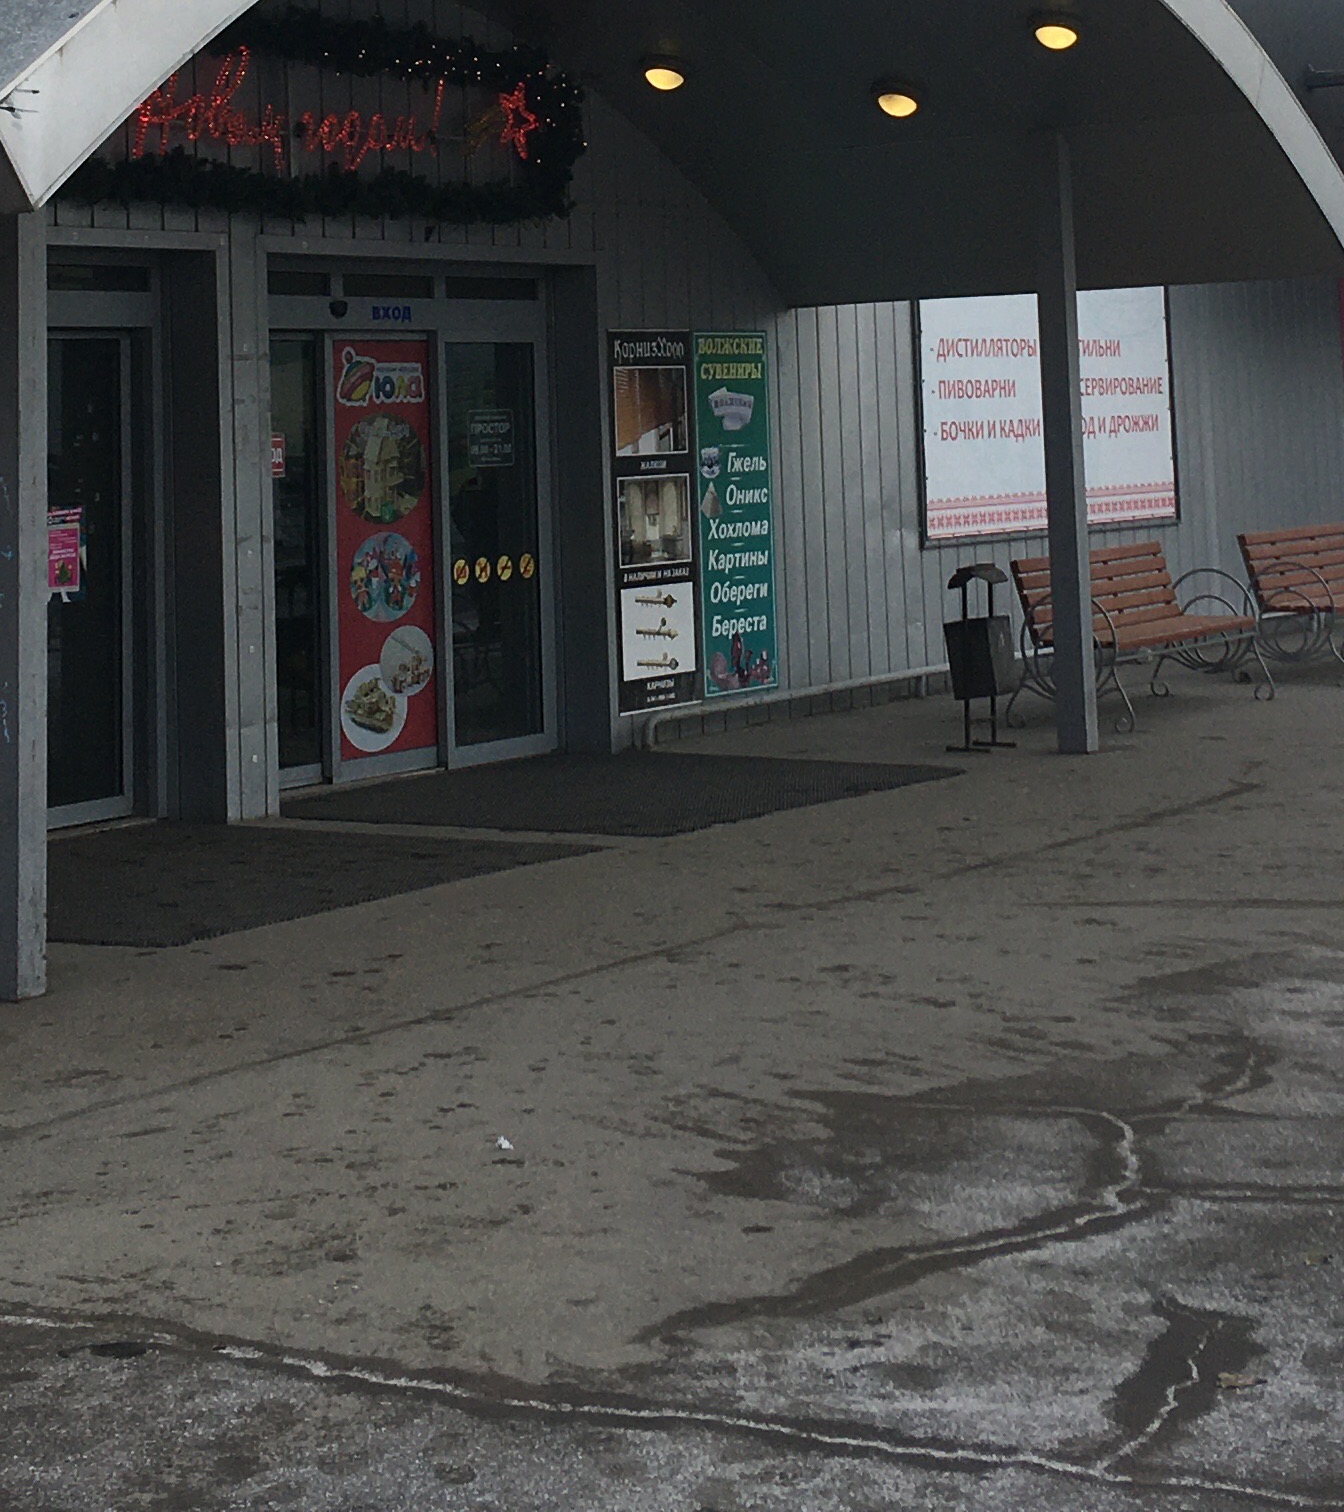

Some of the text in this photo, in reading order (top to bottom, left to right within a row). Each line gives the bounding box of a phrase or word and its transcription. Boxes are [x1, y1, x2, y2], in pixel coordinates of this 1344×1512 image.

[372, 305, 412, 322] ВХОД
[697, 338, 763, 355] ВОЛЖСКИЕ
[936, 338, 1036, 362] ДИСТИЛЛЯТОРЫ
[700, 362, 762, 380] СУВЕНИРЫ
[938, 376, 1163, 399] ПИВОВАРНИ СЕРВИРОВАНИЕ
[940, 421, 984, 441] БОЧКИ
[987, 420, 996, 439] И
[999, 418, 1041, 443] КАДКИ
[1098, 416, 1106, 433] И
[1108, 413, 1159, 437] ДРОЖЖИ
[727, 451, 767, 473] Гжель
[726, 484, 768, 507] Оникс
[708, 517, 768, 540] Хохлома
[708, 549, 768, 571] Картины
[710, 579, 768, 604] Обереги
[712, 612, 767, 637] Береста
